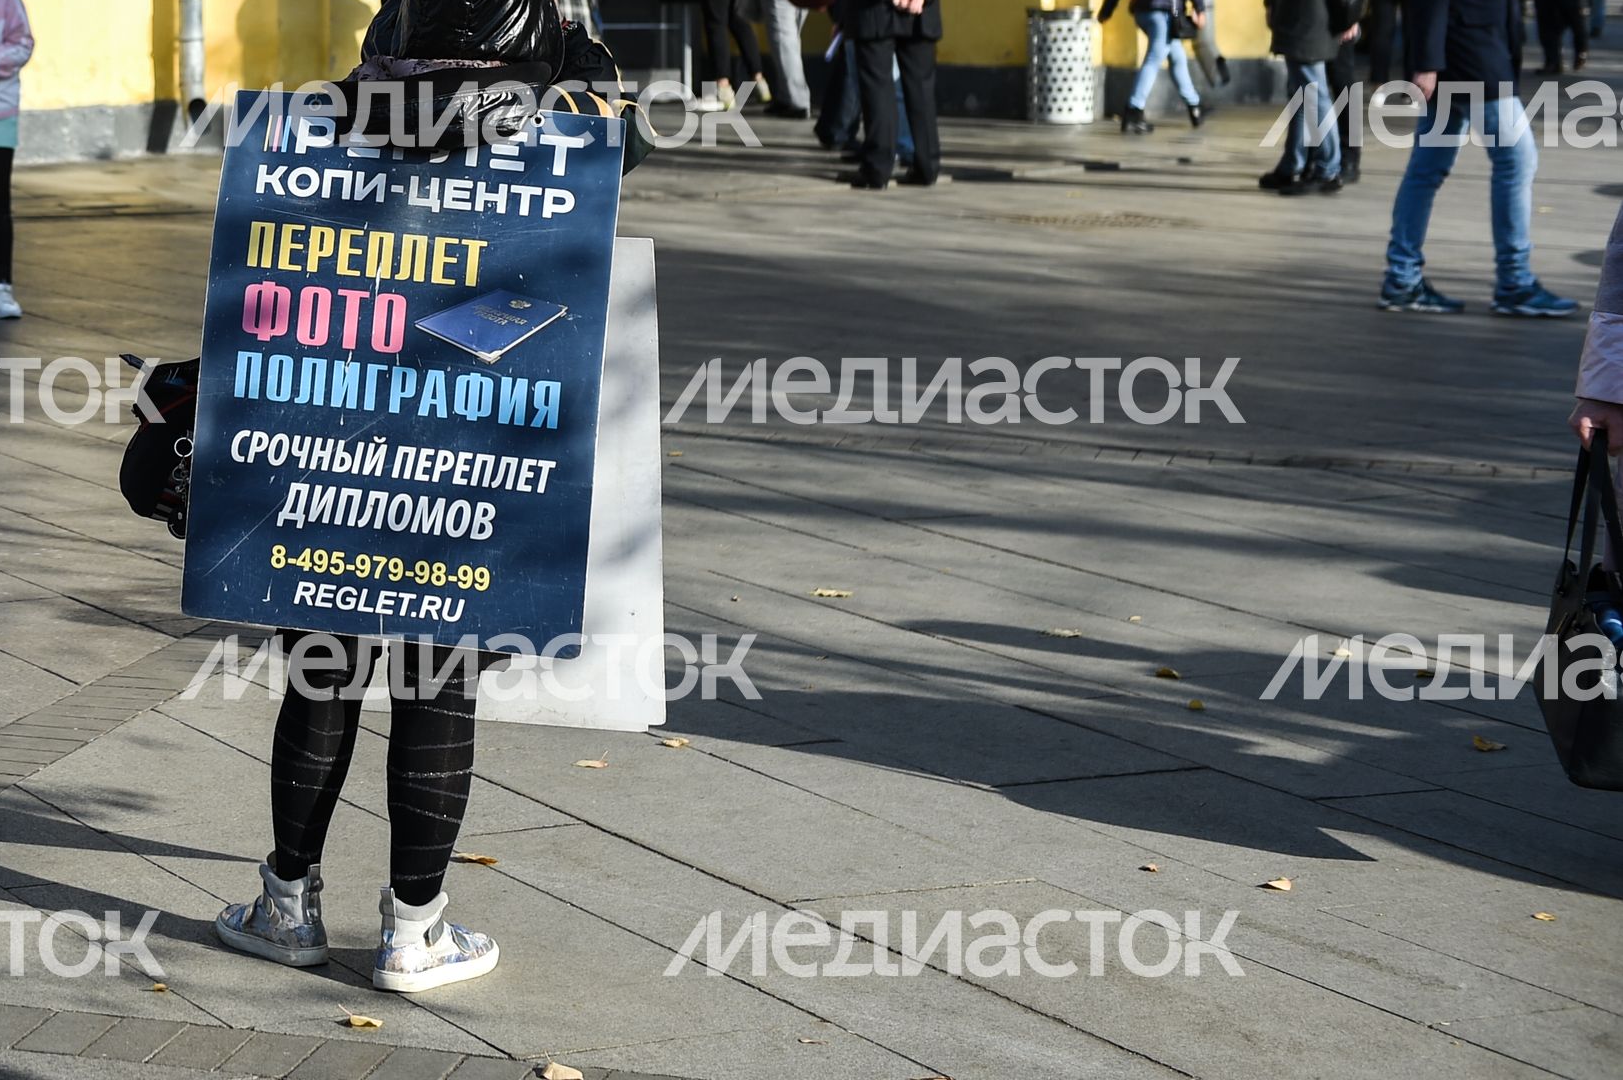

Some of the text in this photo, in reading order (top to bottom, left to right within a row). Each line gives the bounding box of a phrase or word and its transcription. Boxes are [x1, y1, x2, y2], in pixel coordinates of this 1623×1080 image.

[255, 164, 576, 219] КОПИ-ЦЕНТР
[246, 221, 489, 287] ПЕРЕПЛЕТ
[241, 281, 408, 353] ФОТО
[234, 350, 562, 429] ПОЛИГРАФИЯ
[231, 429, 557, 494] СРОЧНЫЙ ПЕРЕПЛЕТ
[277, 482, 497, 541] ДИПЛОМОВ
[270, 545, 491, 592] 8-495-979-98-99
[293, 581, 466, 622] REGLET.RU
